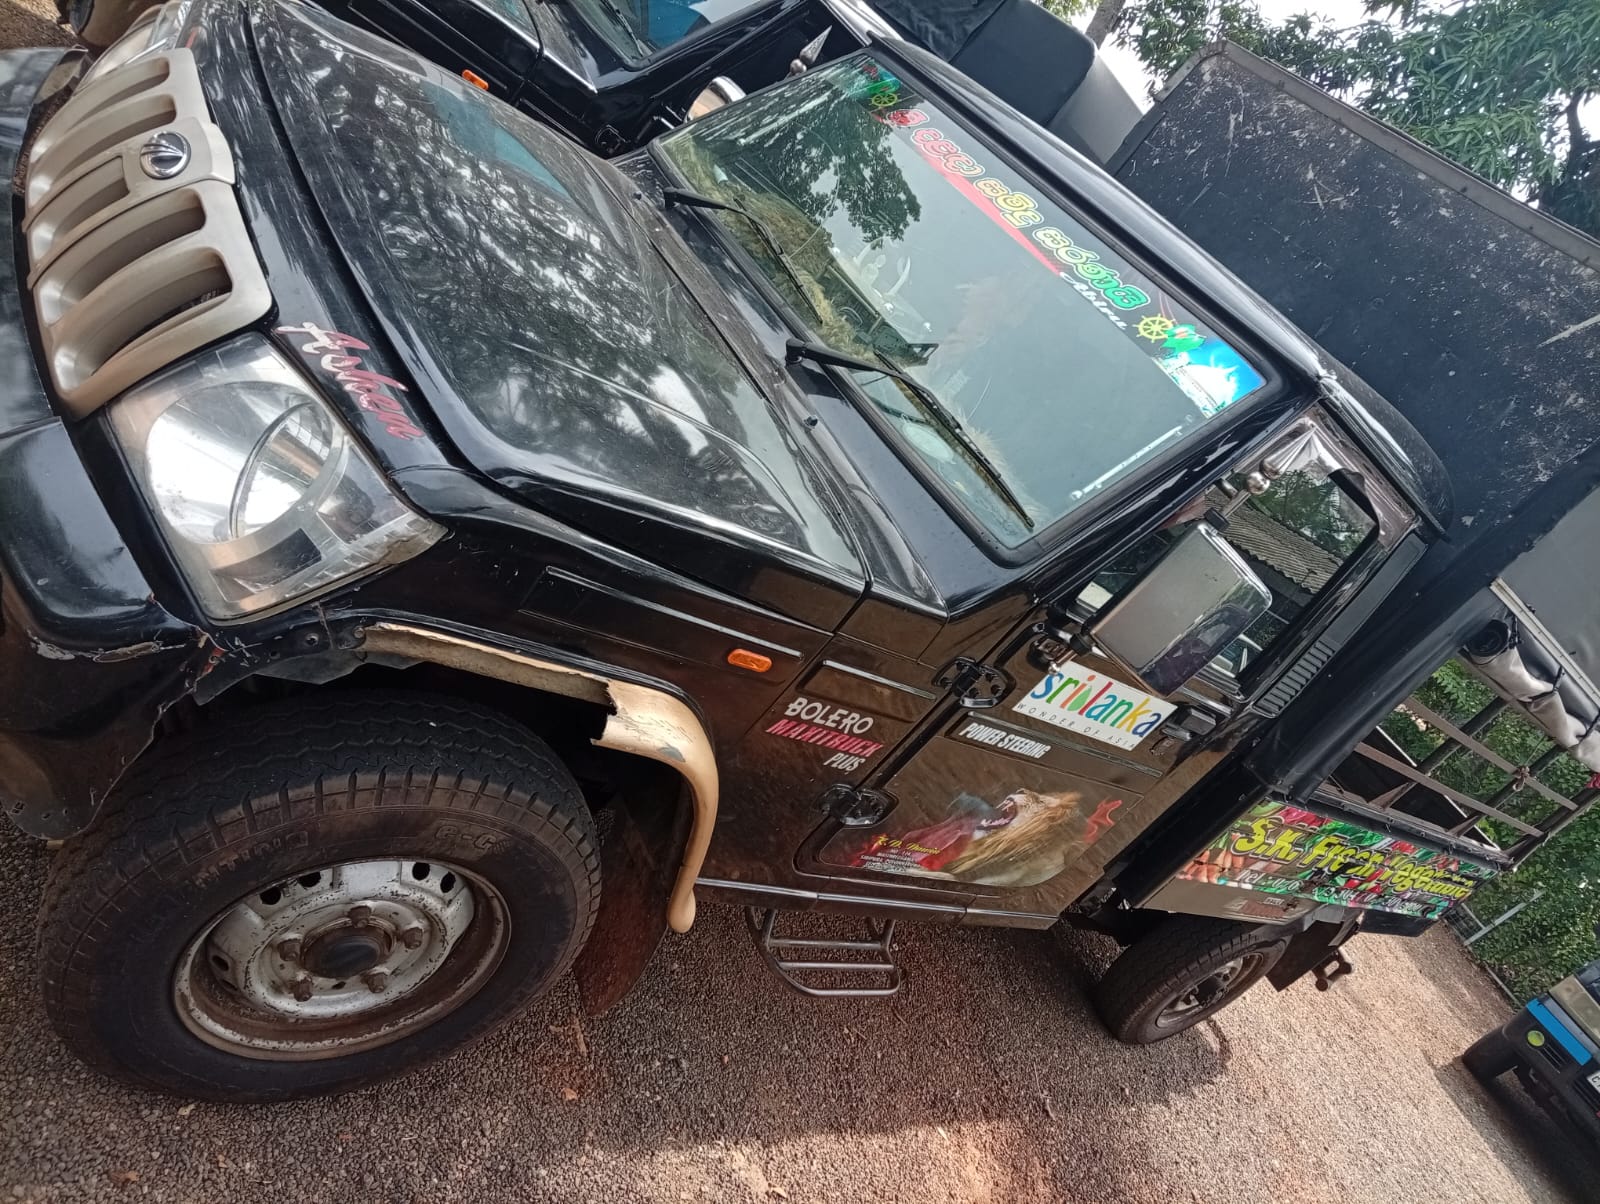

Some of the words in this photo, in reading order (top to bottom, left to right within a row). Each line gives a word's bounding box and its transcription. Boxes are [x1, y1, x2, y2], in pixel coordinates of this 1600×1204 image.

[784, 697, 874, 734] BOLERO
[1017, 703, 1075, 729] WONDER
[1083, 724, 1102, 737] OF
[765, 719, 884, 757] MAXITRUCK
[958, 722, 1007, 746] POWER
[997, 733, 1052, 759] STEERING
[823, 752, 866, 772] PLUS
